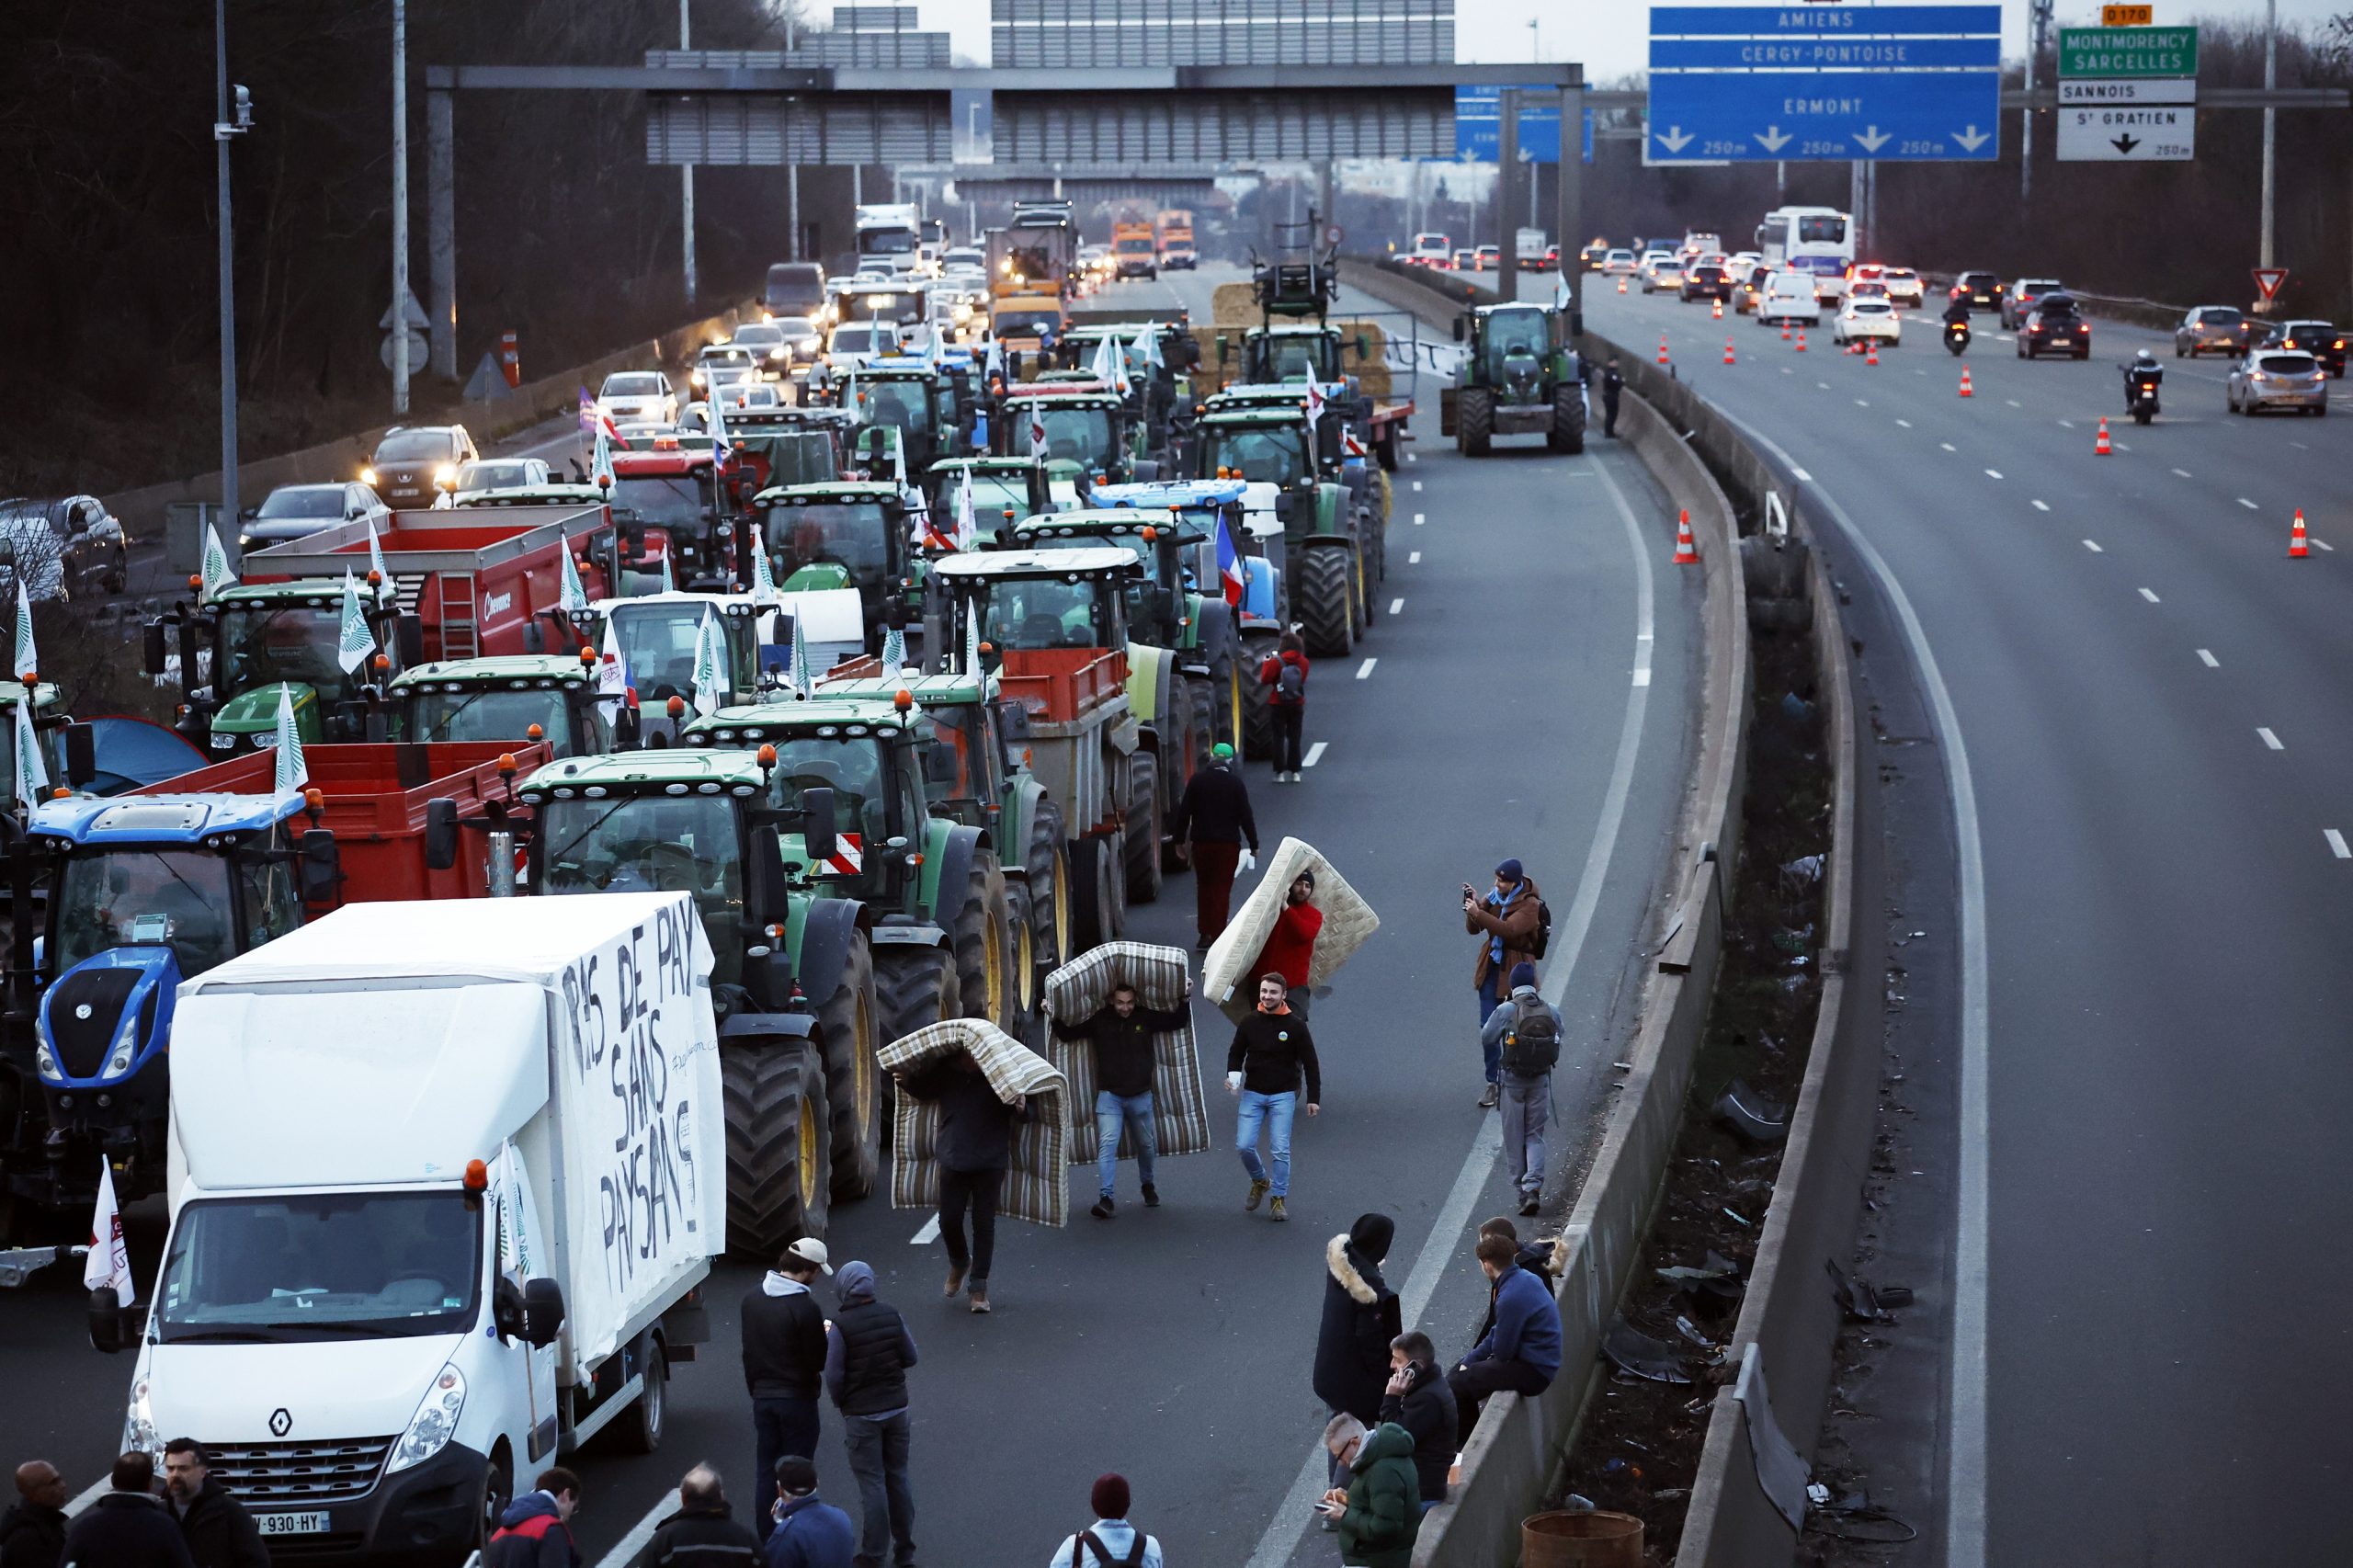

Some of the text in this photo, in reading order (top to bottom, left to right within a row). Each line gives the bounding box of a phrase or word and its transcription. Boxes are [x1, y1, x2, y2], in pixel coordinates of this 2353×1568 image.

[1779, 12, 1854, 28] AMIENS
[2066, 33, 2189, 50] MONTMORENCY
[1742, 46, 1907, 62] CERGY-PONTOISE
[2075, 53, 2182, 70] SARCELLES
[2063, 85, 2135, 98] SANNOIS
[1784, 97, 1863, 115] ERMONT
[2103, 112, 2177, 125] GRATIEN
[618, 925, 648, 1033] DE
[611, 1009, 667, 1153] SANS
